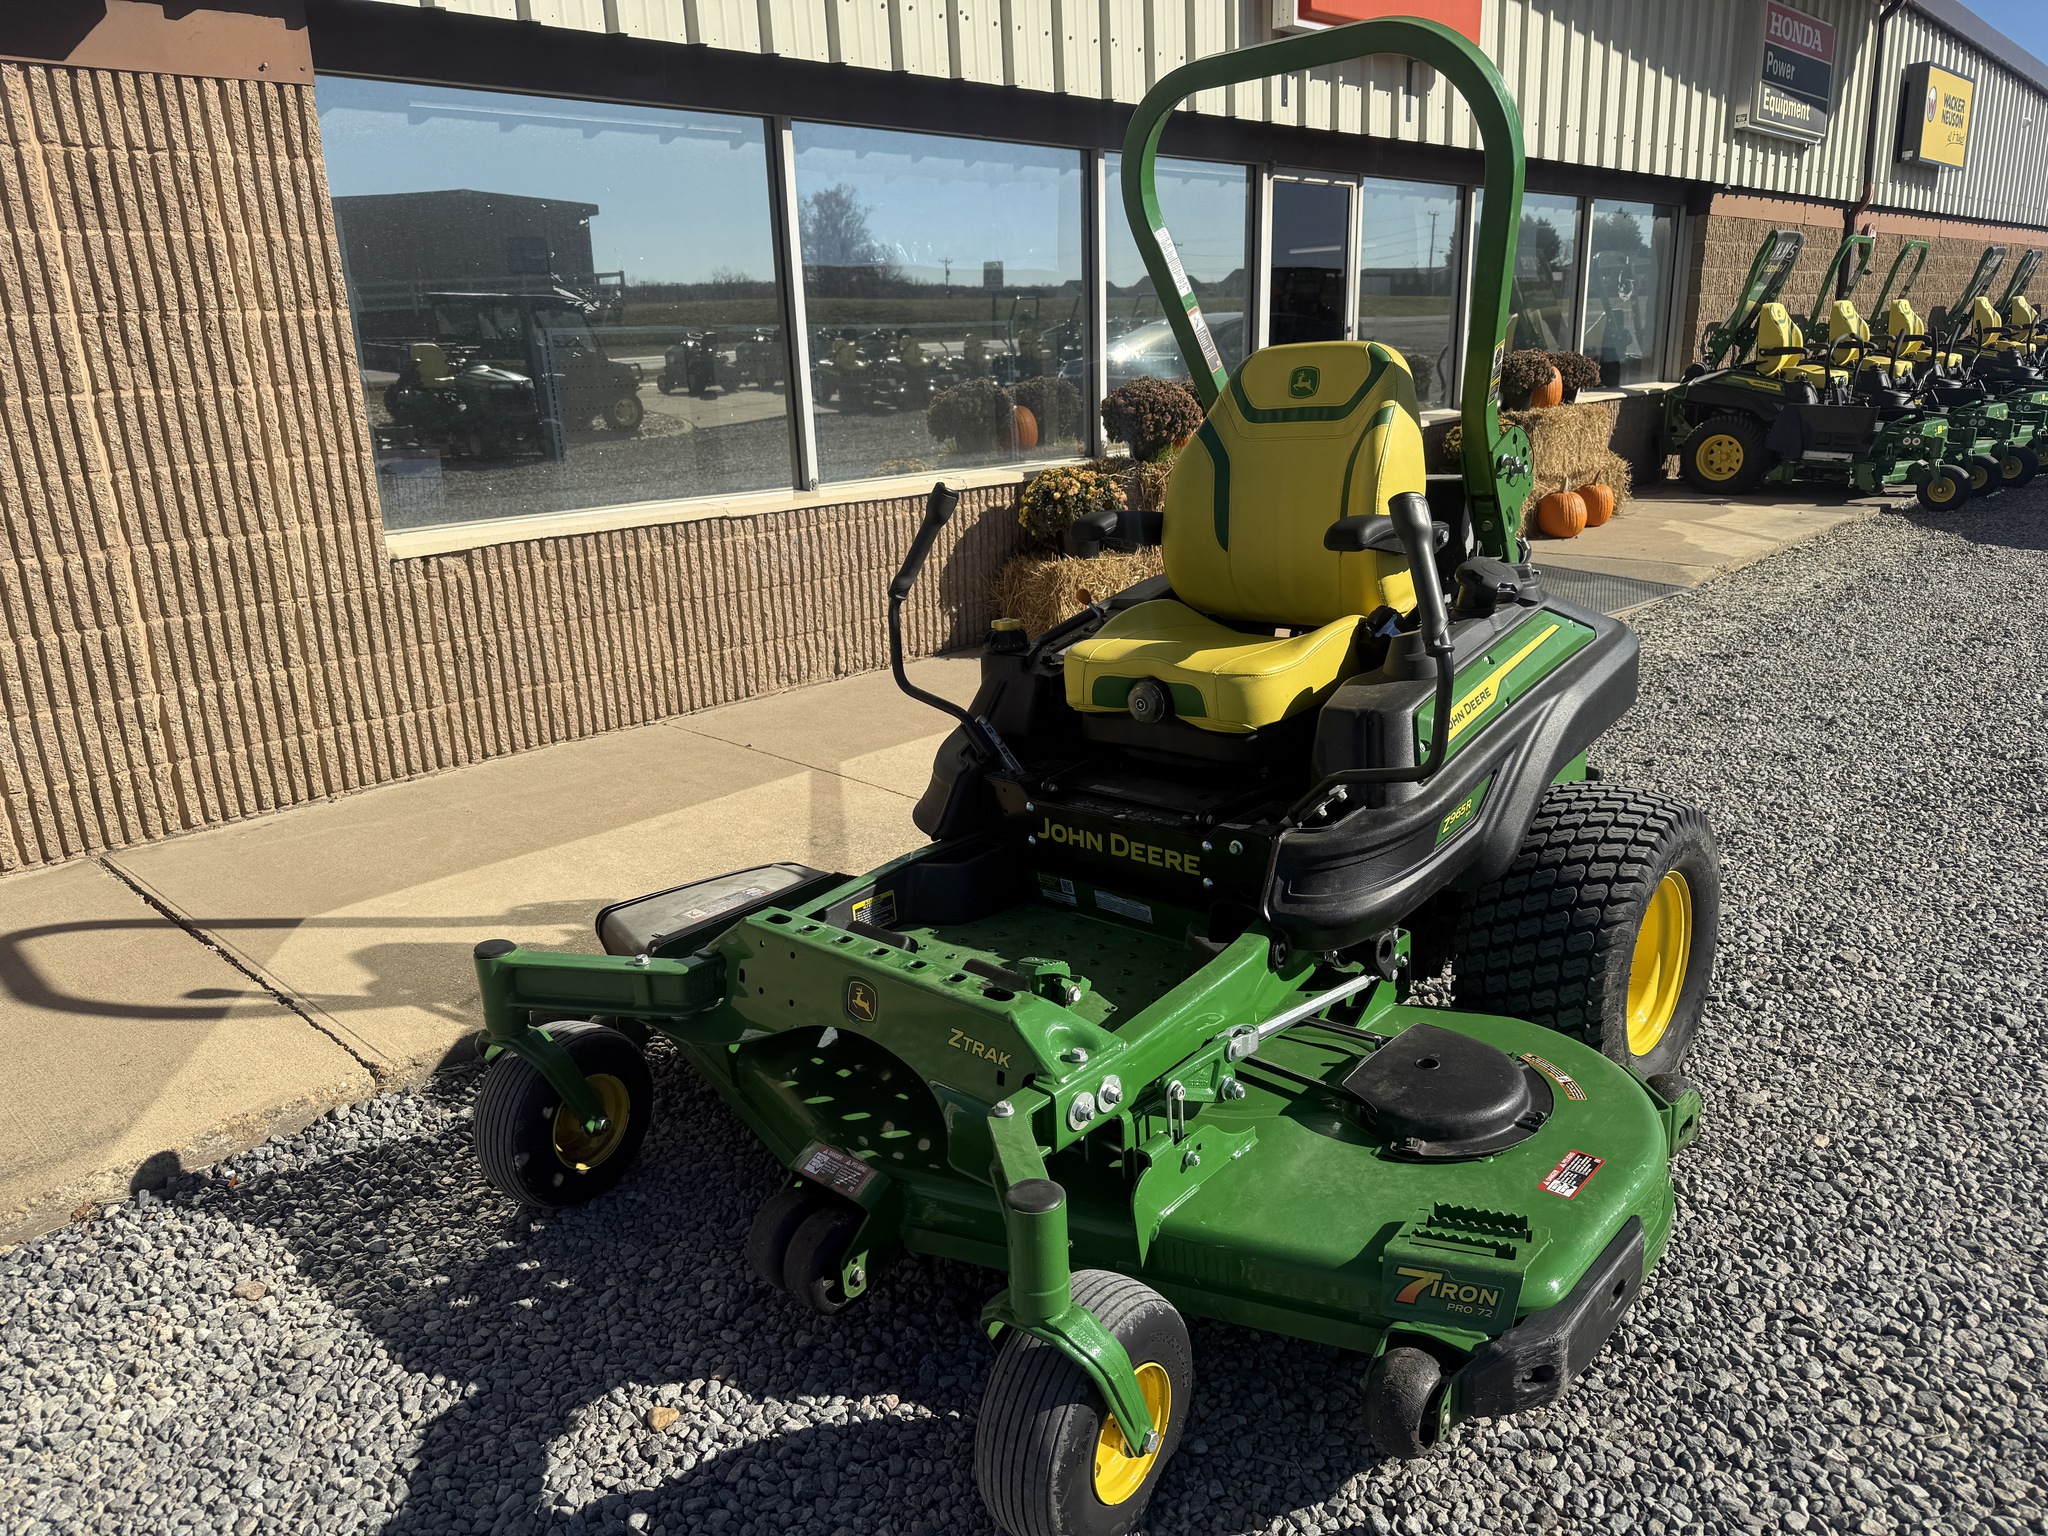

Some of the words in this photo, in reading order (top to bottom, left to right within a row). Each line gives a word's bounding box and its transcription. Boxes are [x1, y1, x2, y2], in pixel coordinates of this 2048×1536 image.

[1769, 11, 1823, 53] HONDA
[1766, 50, 1796, 81] Power
[1763, 87, 1811, 121] Equipment
[1941, 109, 1964, 128] NEUSON
[1944, 93, 1965, 113] WACKER
[1449, 709, 1465, 731] OHN
[1463, 687, 1492, 716] DEERE
[1442, 798, 1472, 834] Z965R
[1037, 817, 1103, 853] JOHN
[1110, 832, 1201, 876] DEERE
[947, 1027, 1013, 1070] ZTRAK
[1446, 1302, 1473, 1315] PRO
[1477, 1307, 1493, 1318] 72
